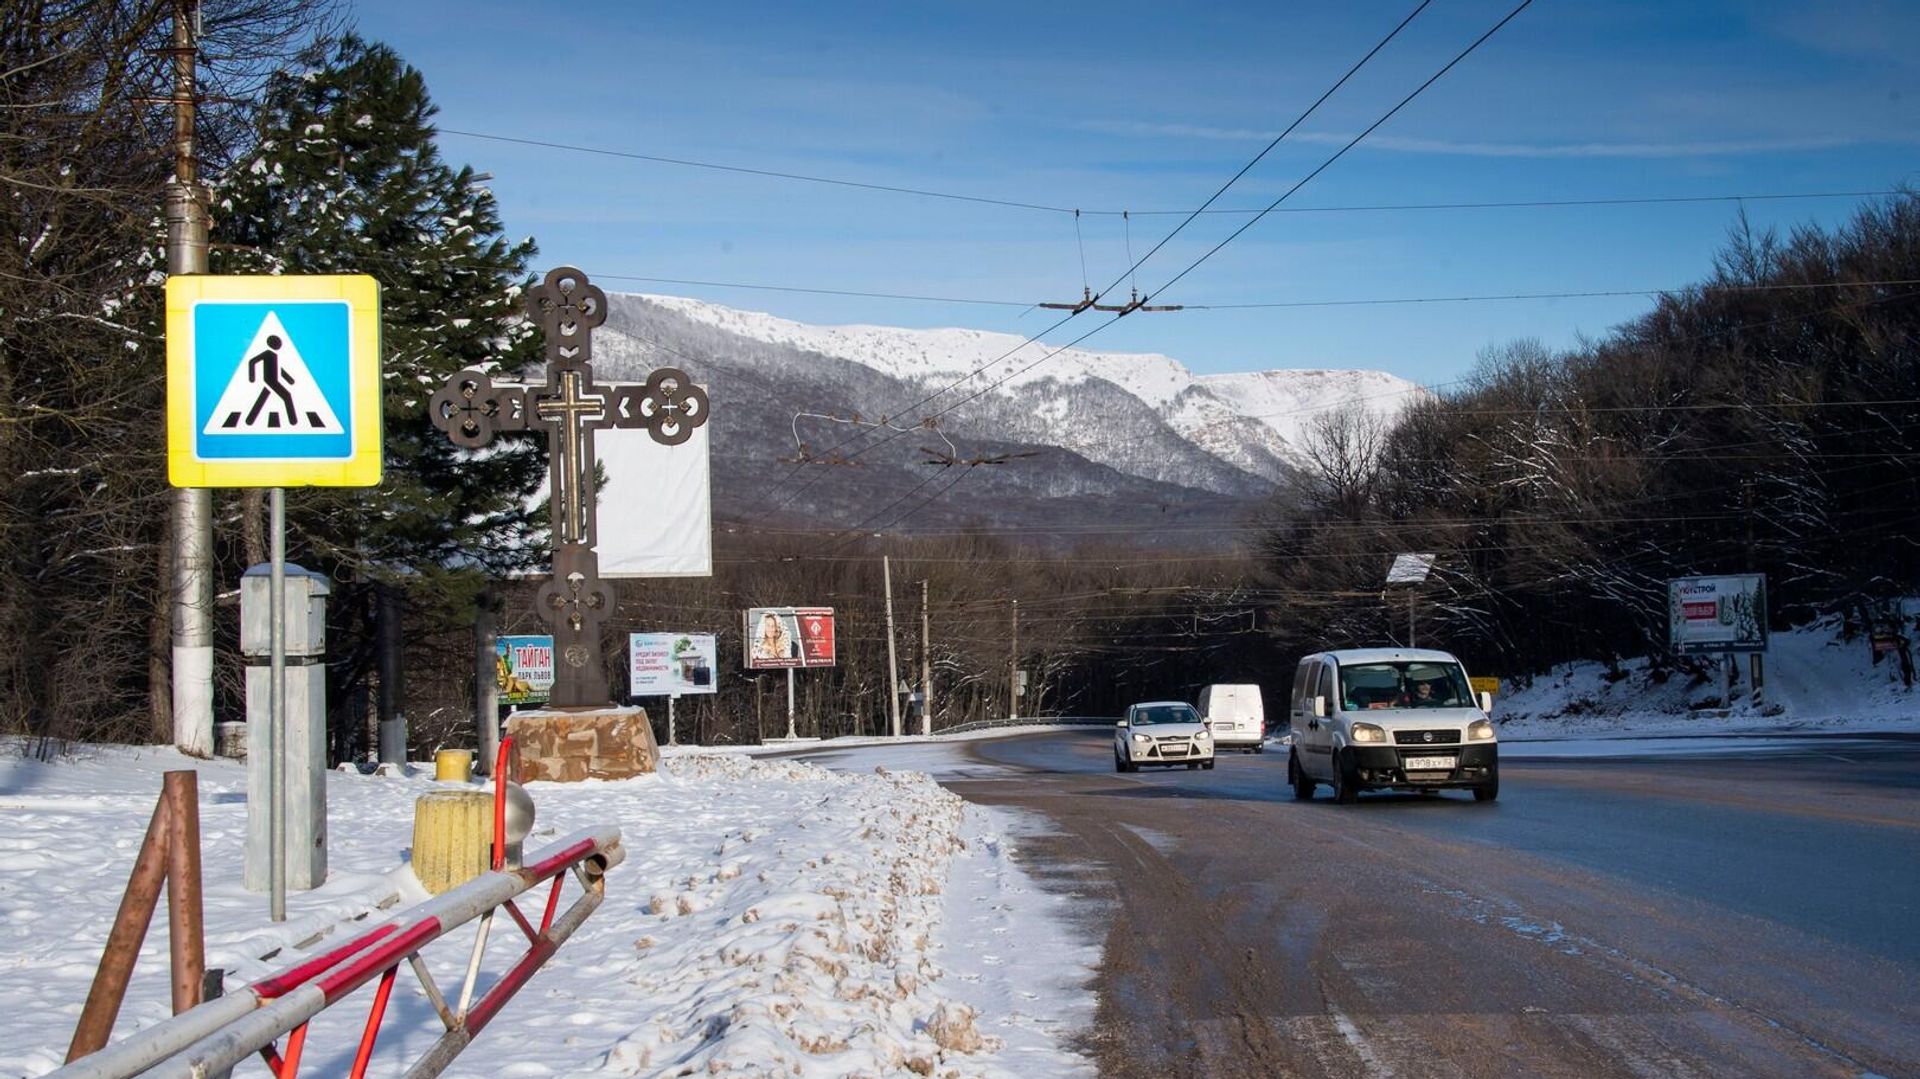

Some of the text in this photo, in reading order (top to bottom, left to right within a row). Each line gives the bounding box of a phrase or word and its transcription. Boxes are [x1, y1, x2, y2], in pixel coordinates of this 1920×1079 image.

[516, 644, 551, 668] ТАЙГАН
[518, 671, 551, 680] ПАРК ЛЬВОВ
